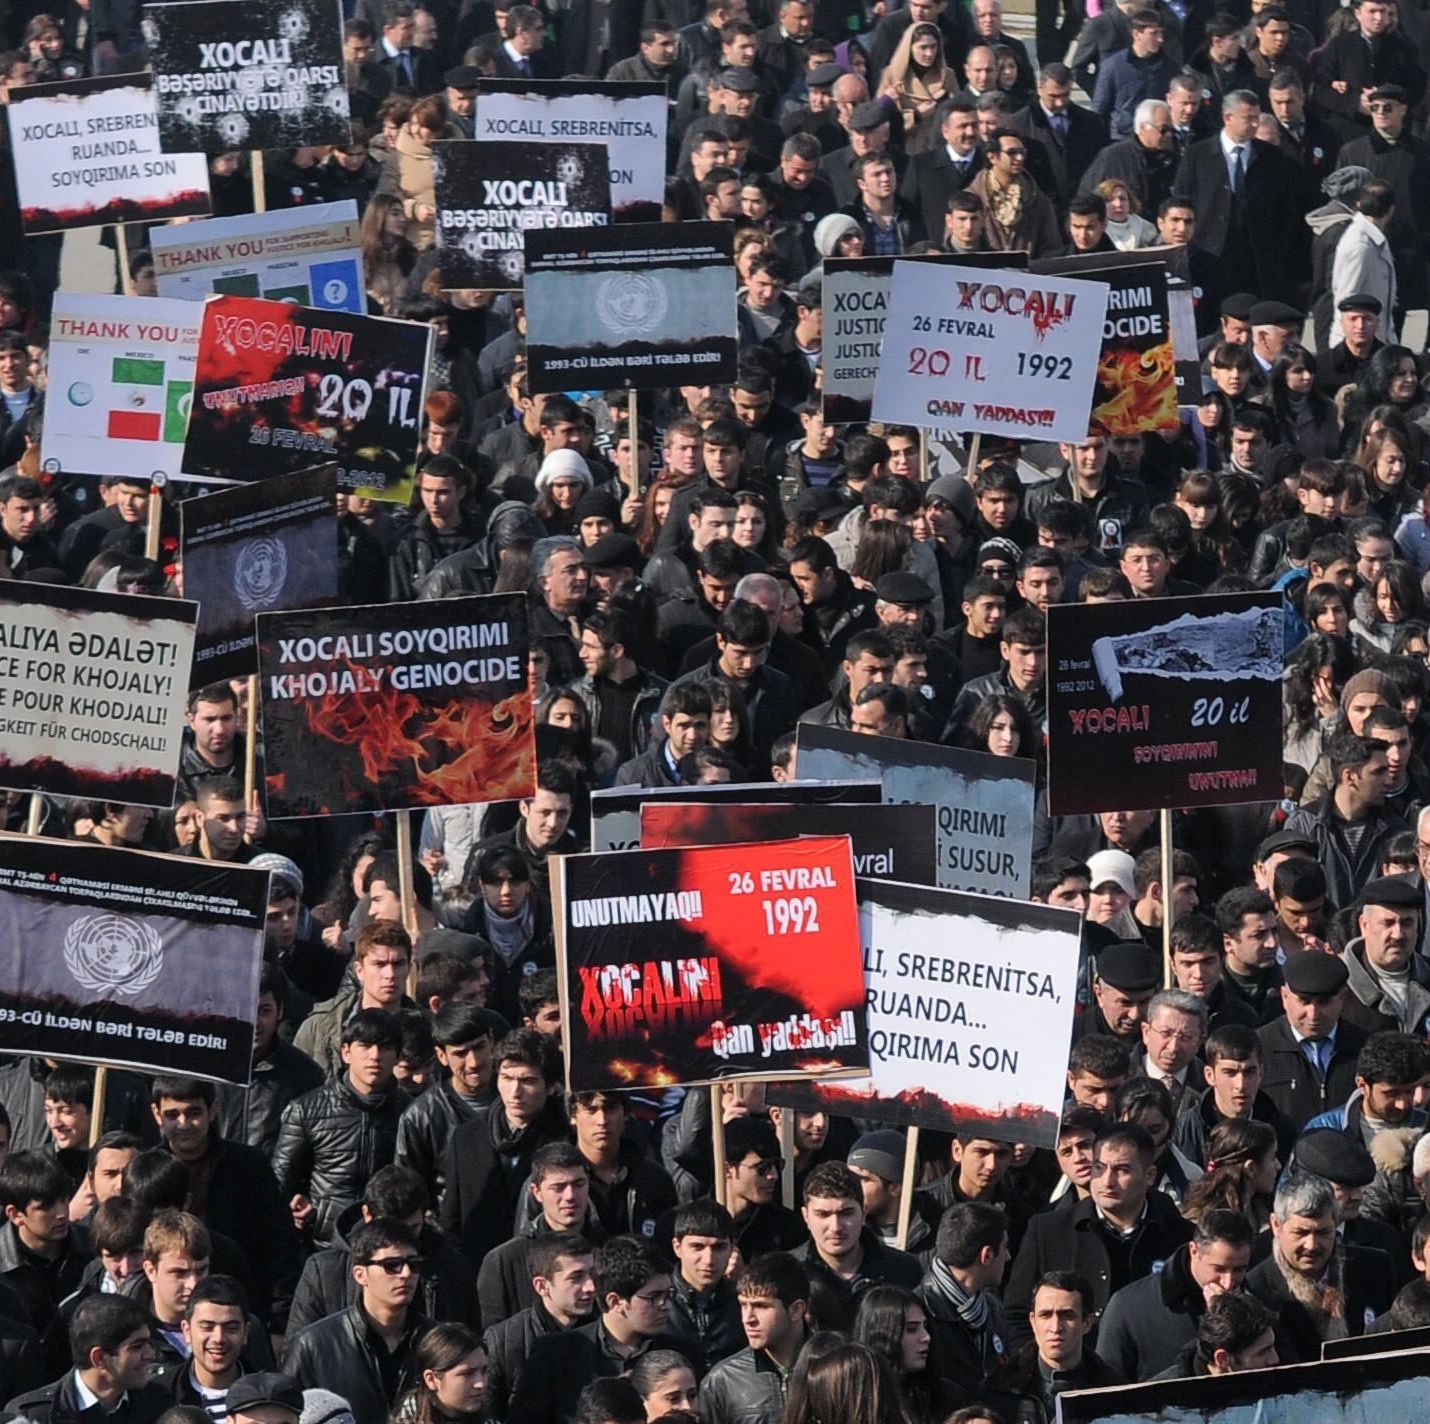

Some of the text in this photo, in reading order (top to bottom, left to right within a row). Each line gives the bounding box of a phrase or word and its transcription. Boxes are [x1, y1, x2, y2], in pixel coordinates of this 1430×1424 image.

[144, 160, 176, 178] SON
[158, 246, 222, 269] THANK
[225, 241, 264, 258] YOU
[59, 319, 179, 342] THANK YOU
[912, 315, 995, 338] 26 FEVRAL
[909, 348, 1073, 380] 20 1992
[317, 374, 372, 422] 20
[250, 424, 338, 454] 26 FEVRAL
[279, 622, 509, 663] XOCALI SOYQIRIMI
[26, 660, 66, 683] FOR
[73, 665, 172, 696] KHOJALY!
[271, 656, 521, 699] KHOJALY GENOCIDE
[12, 689, 63, 712] POUR
[70, 696, 167, 725] KHODJALI!
[1069, 697, 1224, 735] XOCALI 20
[40, 721, 67, 739] FÜR
[948, 846, 1020, 881] SUSUR,
[729, 867, 836, 894] 26 FEVRAL
[763, 896, 819, 935] 1992
[896, 953, 1062, 1004] SREBRENİTSA,
[137, 1027, 185, 1045] TƏLƏB
[188, 1033, 227, 1050] EDİR!
[711, 1020, 754, 1059] Qan
[967, 1044, 1019, 1074] SON
